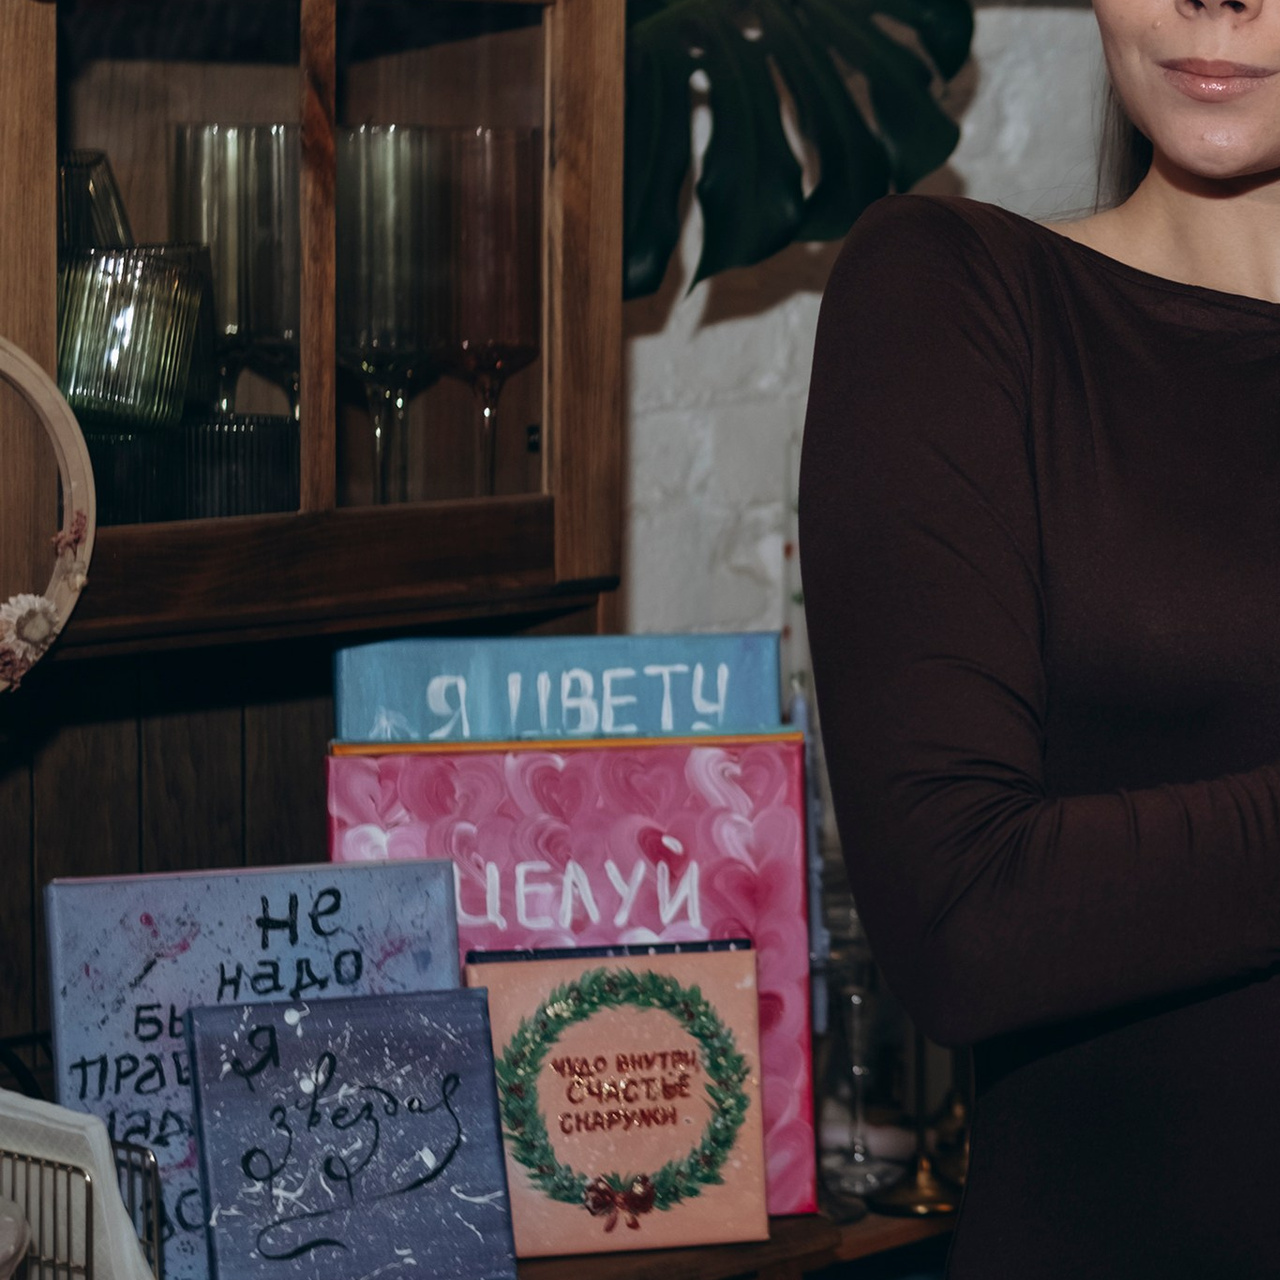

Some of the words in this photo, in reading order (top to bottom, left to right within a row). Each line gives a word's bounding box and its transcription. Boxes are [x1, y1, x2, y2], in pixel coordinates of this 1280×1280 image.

[426, 675, 471, 739] Я
[507, 662, 730, 737] ЦВЕТУ
[231, 1024, 280, 1093] Я
